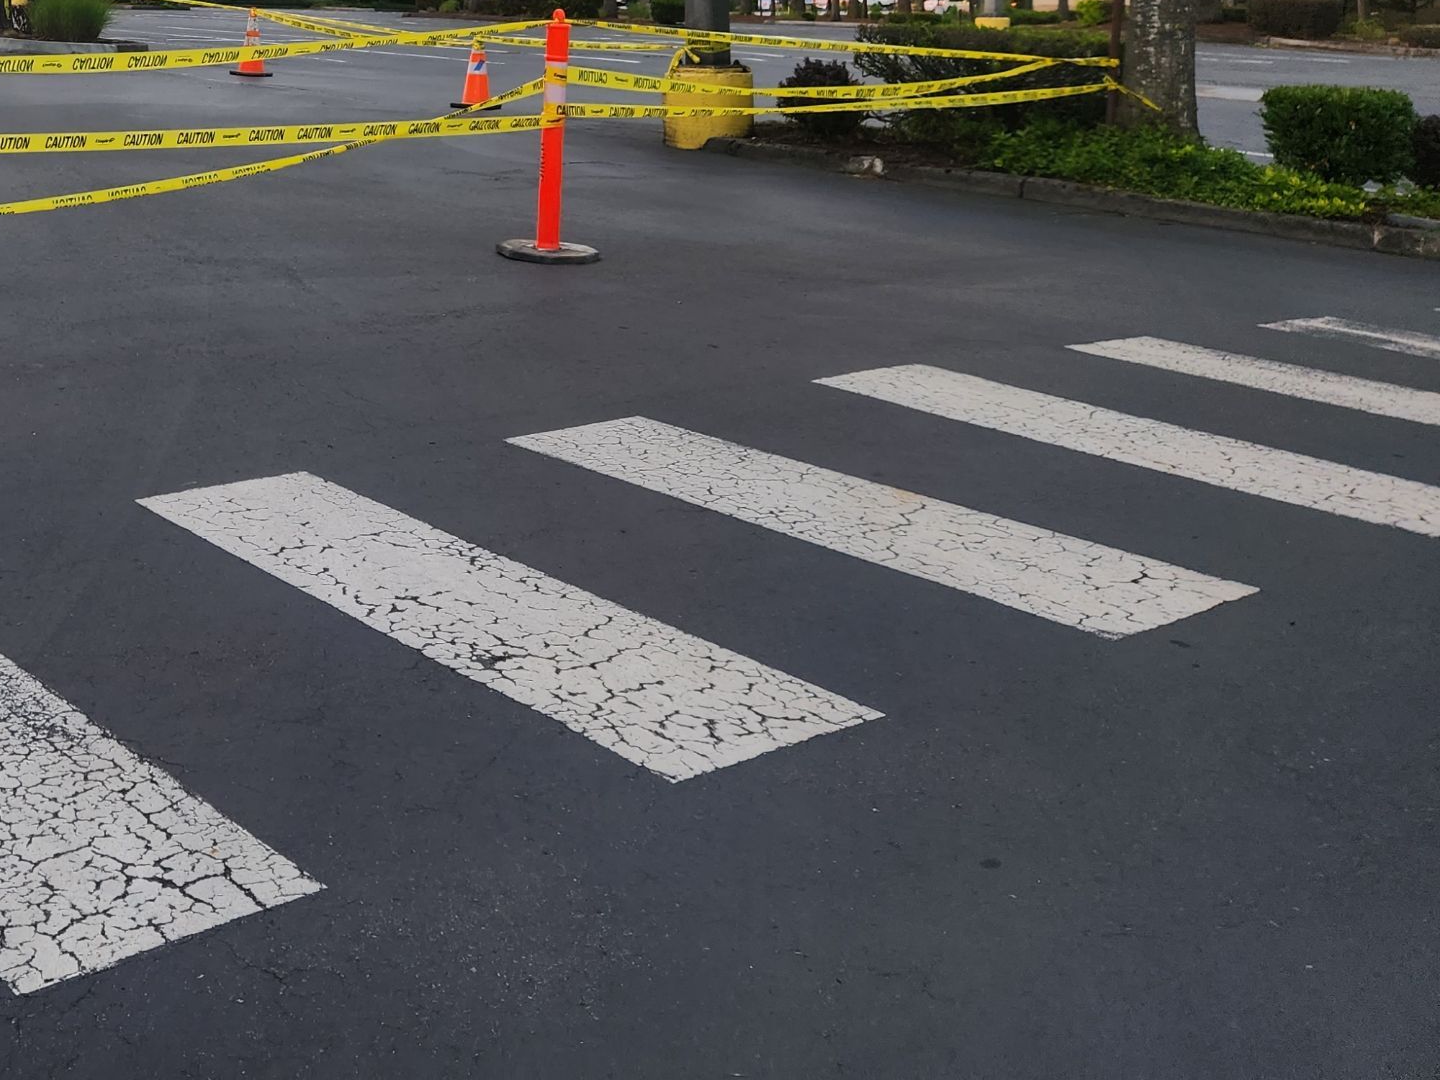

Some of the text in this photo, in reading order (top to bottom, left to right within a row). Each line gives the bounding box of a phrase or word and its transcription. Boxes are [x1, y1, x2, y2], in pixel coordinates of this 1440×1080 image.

[556, 105, 586, 116] CAUTION
[45, 135, 88, 150] CAUTION
[123, 133, 164, 147] CAUTION
[176, 131, 216, 145] CAUTION
[248, 129, 286, 142] CAUTION
[297, 126, 334, 140] CAUTION
[363, 124, 398, 137] CAUTION
[408, 122, 442, 135] CAUTION
